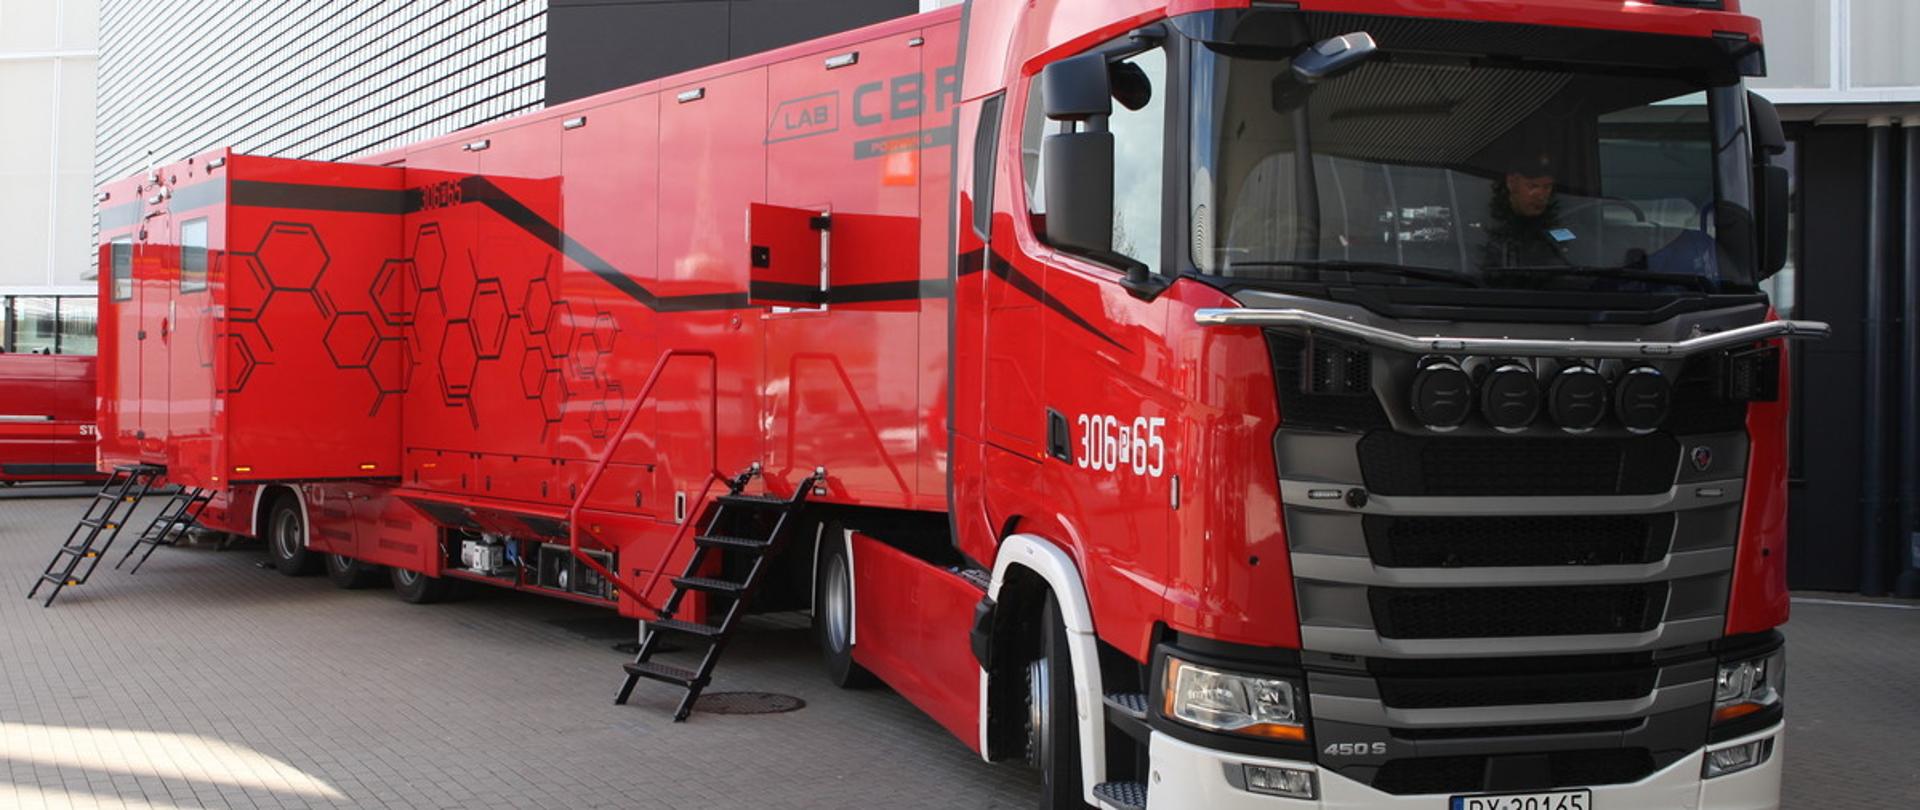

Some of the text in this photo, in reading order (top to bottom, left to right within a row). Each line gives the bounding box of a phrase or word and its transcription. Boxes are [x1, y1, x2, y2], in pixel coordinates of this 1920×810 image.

[784, 106, 829, 131] LAB
[1324, 742, 1387, 755] 450 S
